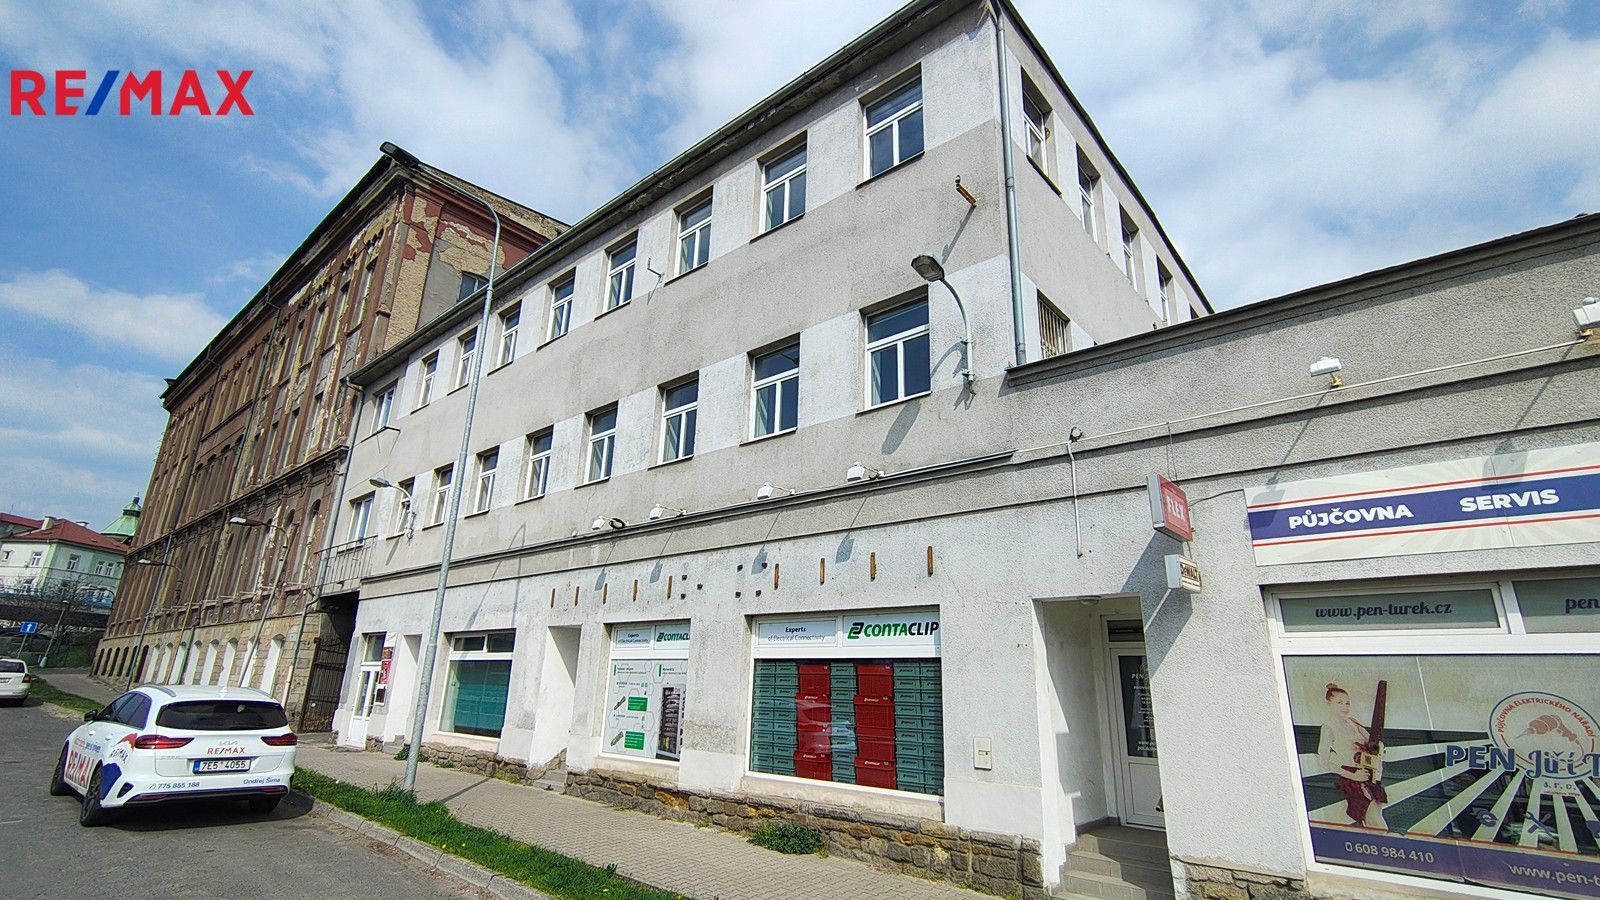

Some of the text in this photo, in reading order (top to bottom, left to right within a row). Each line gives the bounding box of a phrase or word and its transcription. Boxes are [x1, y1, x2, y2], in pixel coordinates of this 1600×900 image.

[1288, 489, 1560, 530] PŮJČOVNA SERVIS
[1315, 602, 1452, 620] www.pen-turek.cz
[785, 626, 806, 634] Experts
[863, 621, 939, 638] CONTACLIP
[206, 747, 246, 755] RE/MAX
[201, 760, 218, 770] 7E5
[224, 760, 246, 769] 4055
[1446, 745, 1516, 772] PEN
[1526, 750, 1577, 778] Jiří
[1355, 843, 1434, 863] 608 984 410
